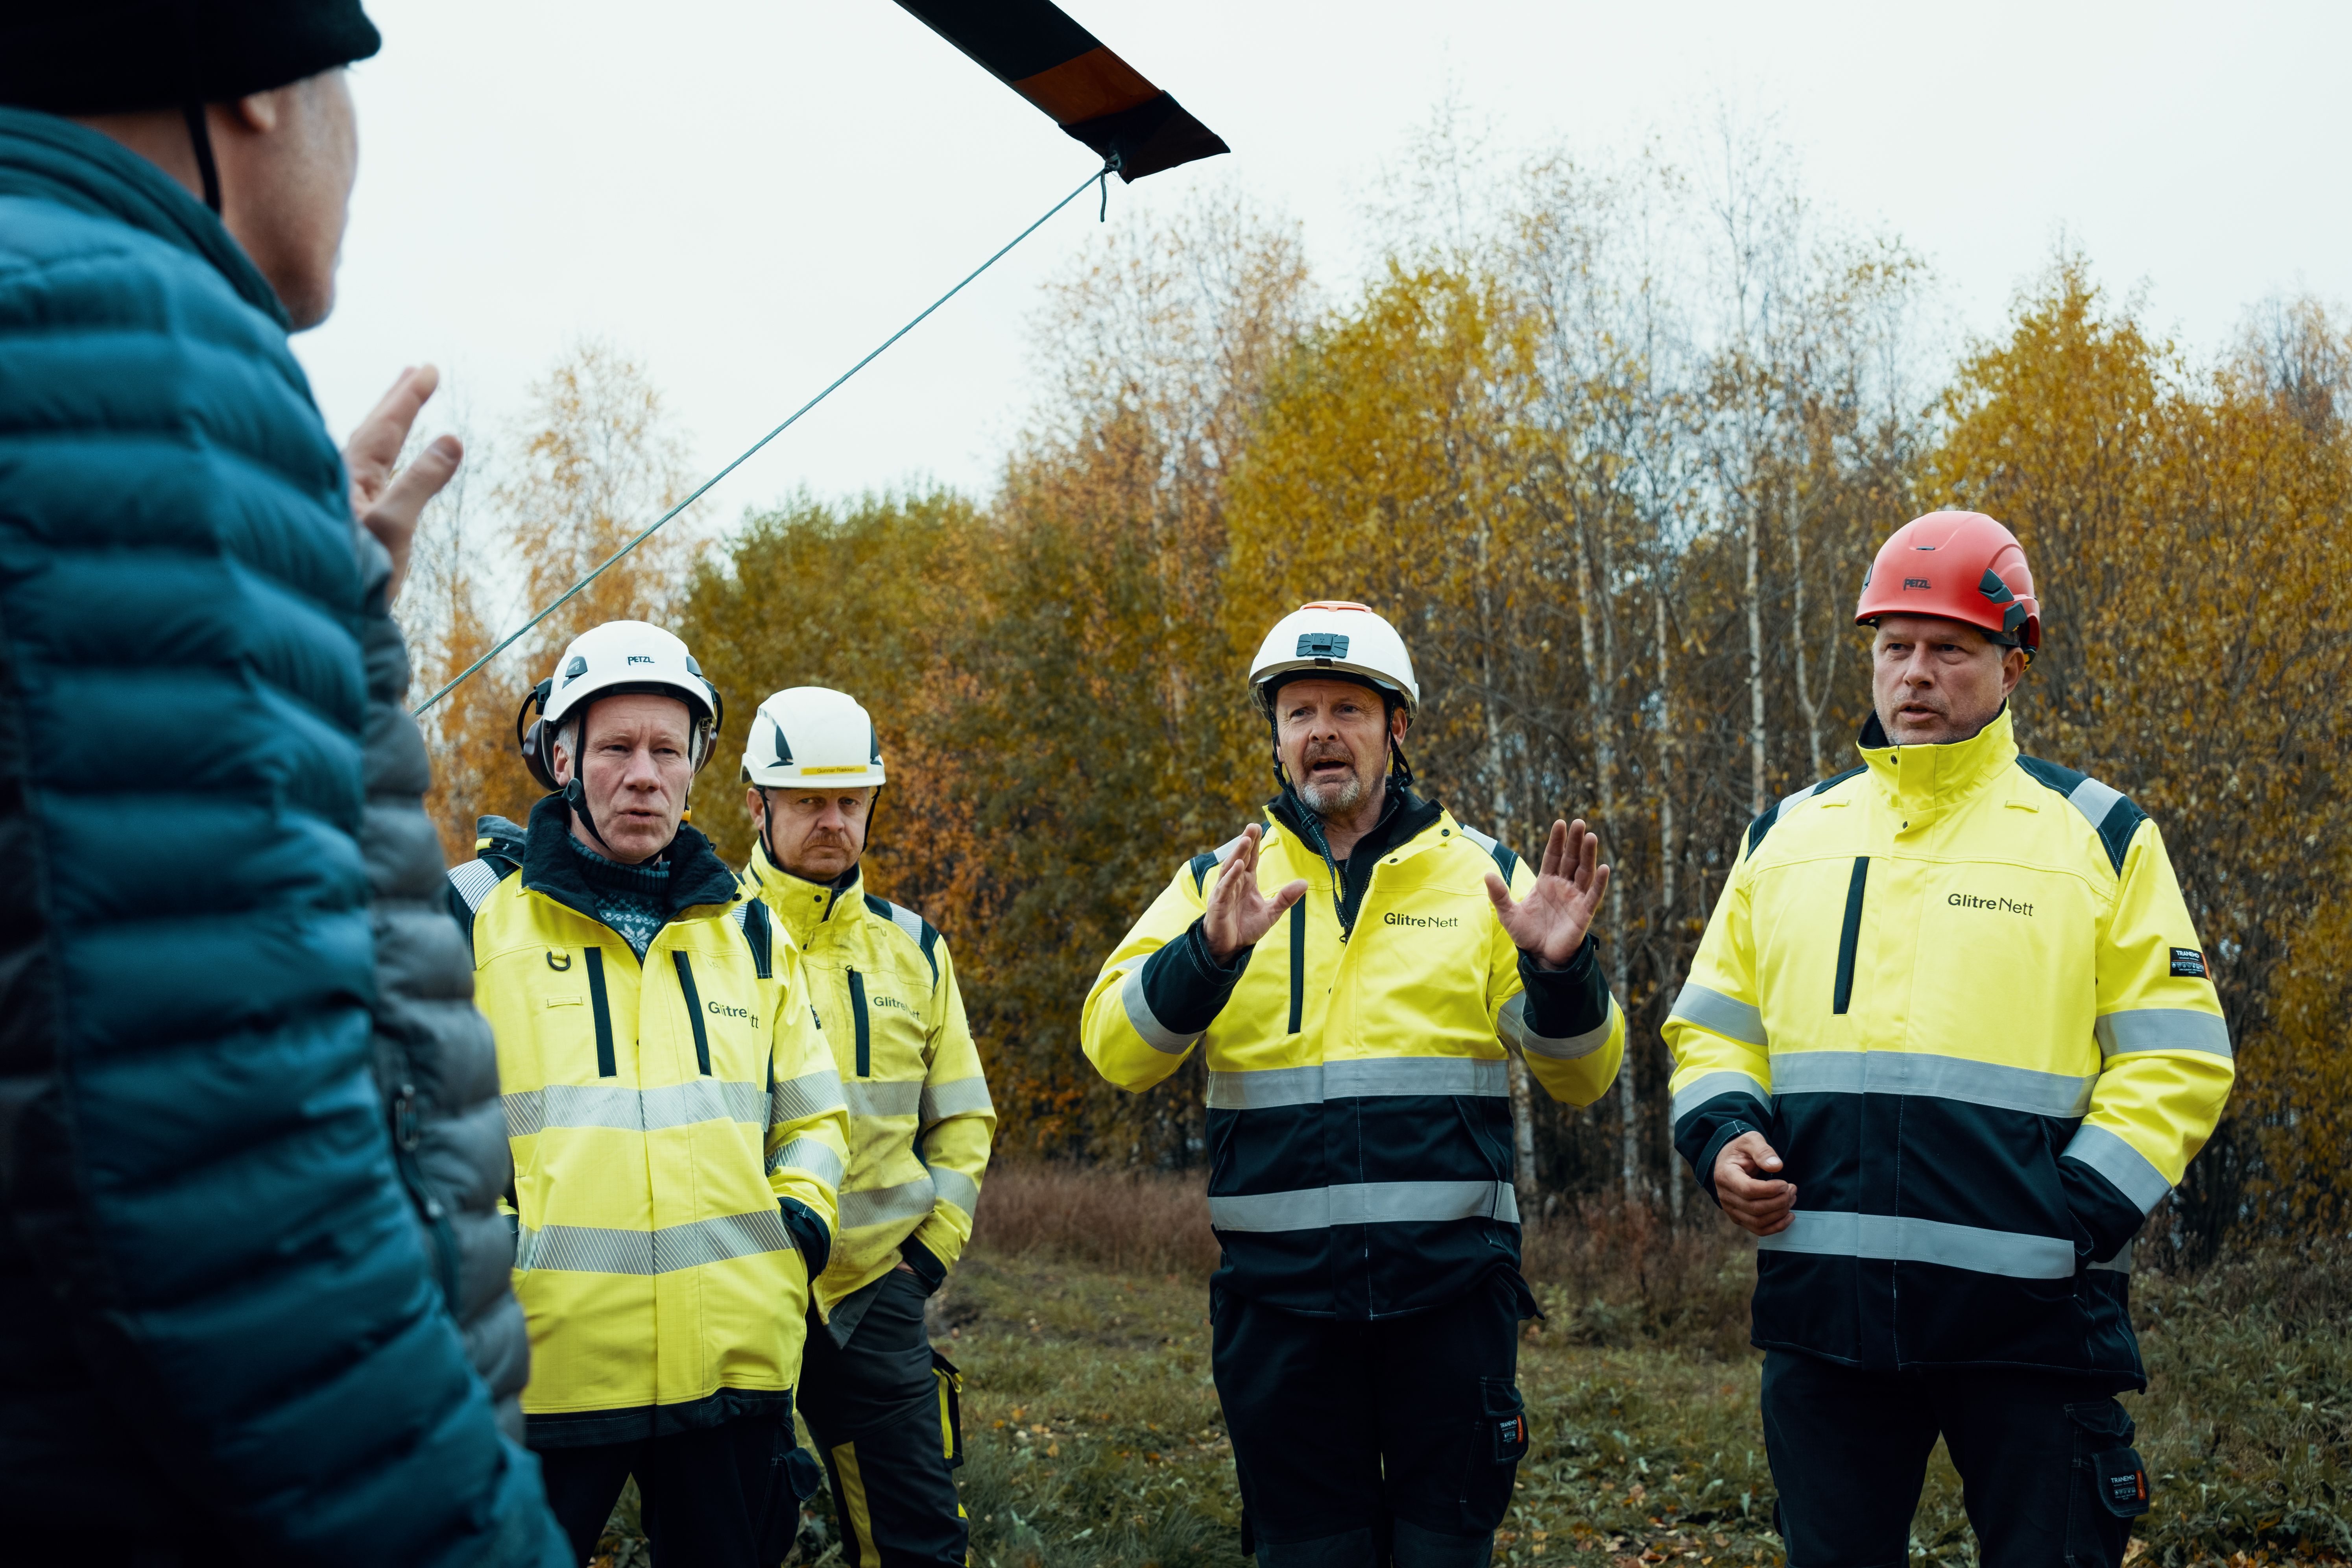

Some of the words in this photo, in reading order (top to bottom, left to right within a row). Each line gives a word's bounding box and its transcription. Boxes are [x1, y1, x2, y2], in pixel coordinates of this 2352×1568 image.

[1903, 579, 1932, 591] PETZL
[628, 656, 655, 666] PETZL
[1948, 893, 1997, 910] Glitre
[1999, 897, 2034, 917] Nett
[1384, 912, 1426, 927] Glitre
[1428, 917, 1458, 927] Nett
[873, 996, 906, 1011] Glitre
[2110, 1474, 2135, 1483] TRANEMO
